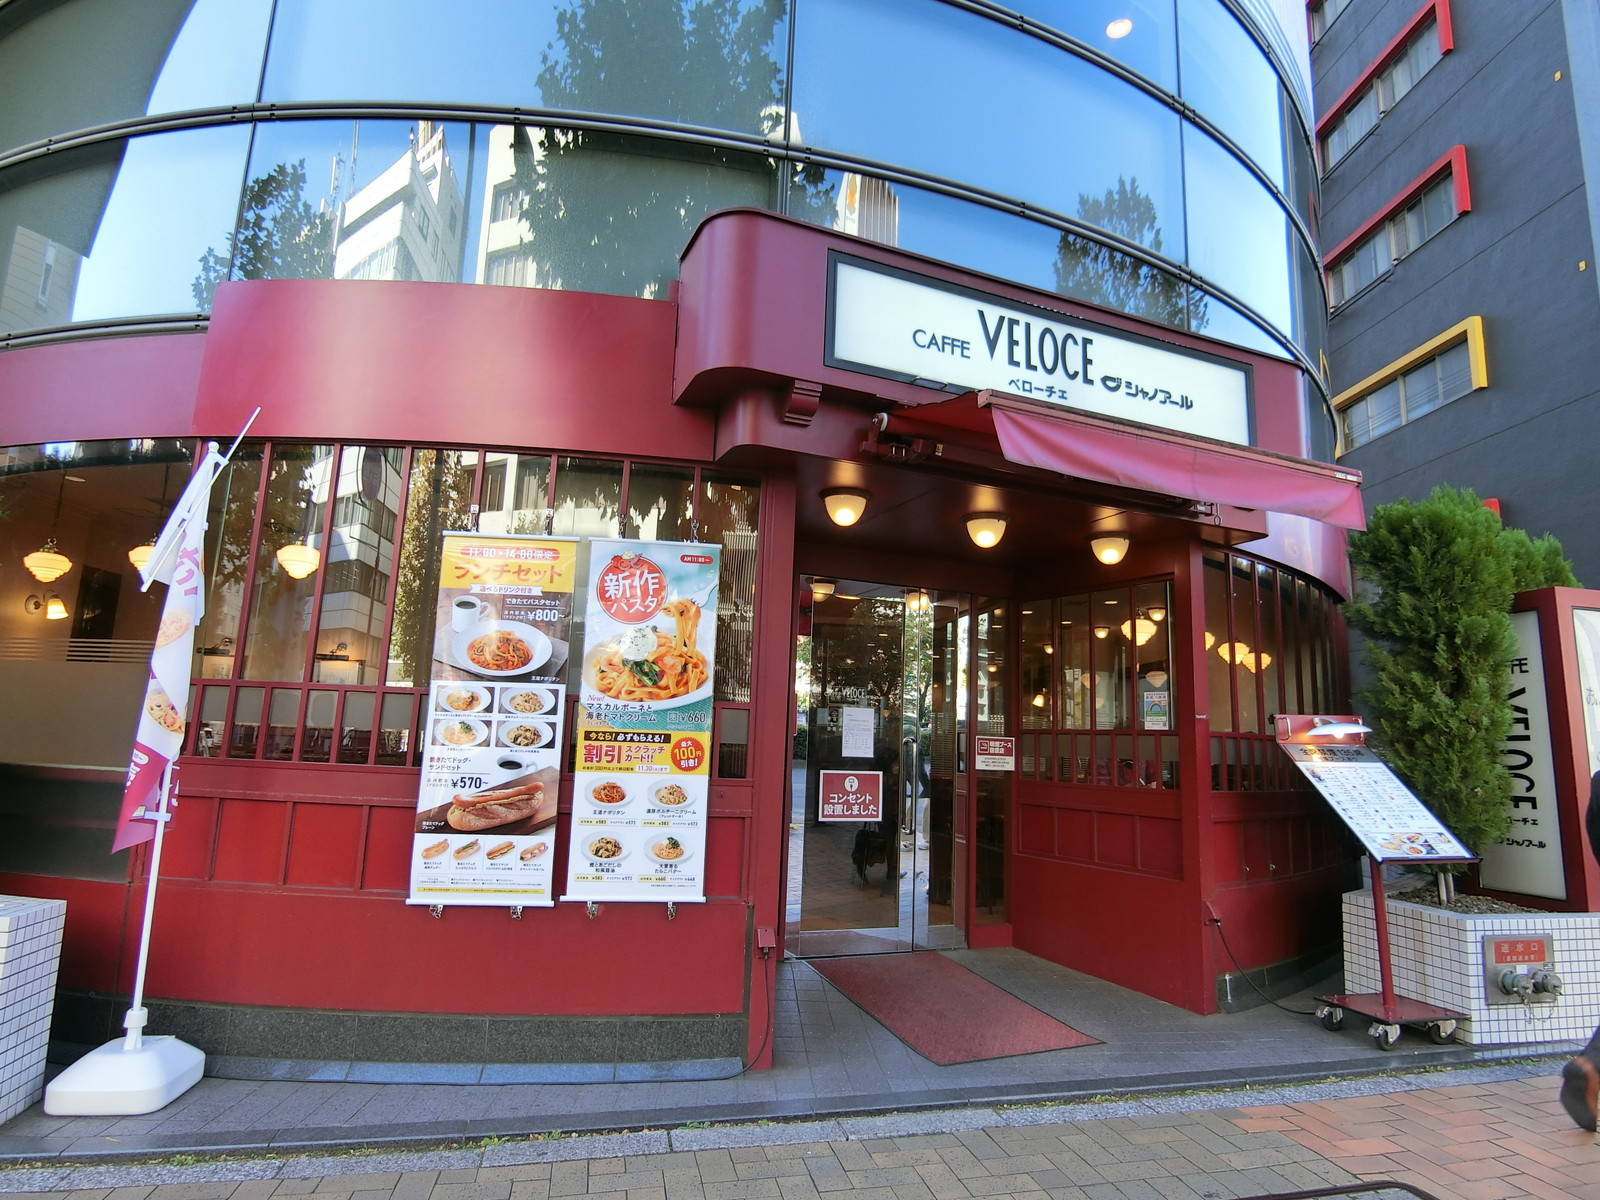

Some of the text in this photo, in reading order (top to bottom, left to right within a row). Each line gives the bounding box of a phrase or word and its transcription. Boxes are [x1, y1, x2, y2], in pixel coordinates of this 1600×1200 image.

[912, 309, 1094, 385] CAFFE VELOCE
[1008, 379, 1068, 400] ベローチェ
[1125, 381, 1193, 410] シャノアール
[454, 562, 562, 584] ランチセット
[604, 569, 660, 599] 新作
[610, 596, 658, 614] パスタ
[586, 703, 653, 713] マスカルポーネと
[585, 712, 656, 722] 海老トマトクリーム
[680, 711, 706, 723] ¥660
[583, 743, 622, 764] 割引
[625, 745, 665, 755] スクラッチ
[673, 746, 701, 761] 100円
[625, 754, 654, 763] カード!!
[829, 793, 872, 803] コンセント
[823, 804, 877, 815] 設置しました
[1501, 943, 1538, 953] 送水口
